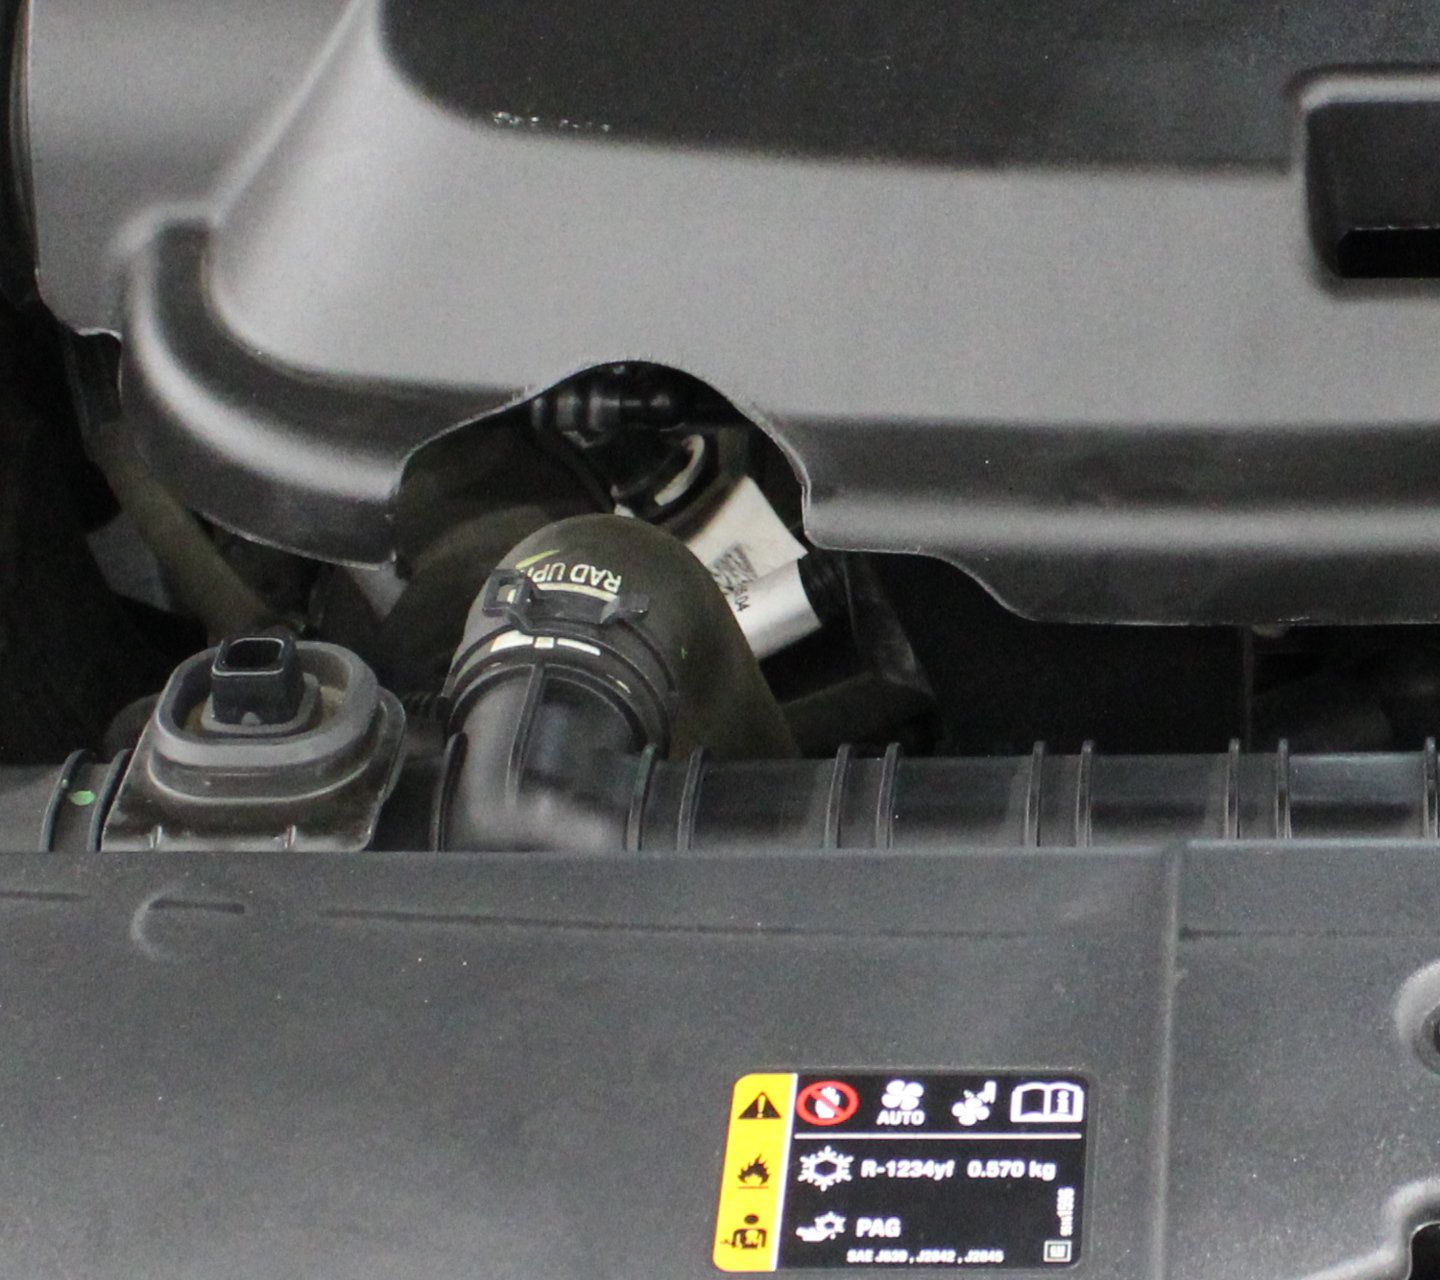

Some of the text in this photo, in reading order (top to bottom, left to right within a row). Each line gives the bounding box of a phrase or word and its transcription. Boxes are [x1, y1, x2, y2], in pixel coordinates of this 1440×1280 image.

[569, 563, 622, 593] RAD
[876, 1109, 927, 1126] AUTO
[860, 1158, 1058, 1182] R-1234yf 0.570 kg
[855, 1216, 902, 1238] PAG
[846, 1248, 874, 1264] SAE
